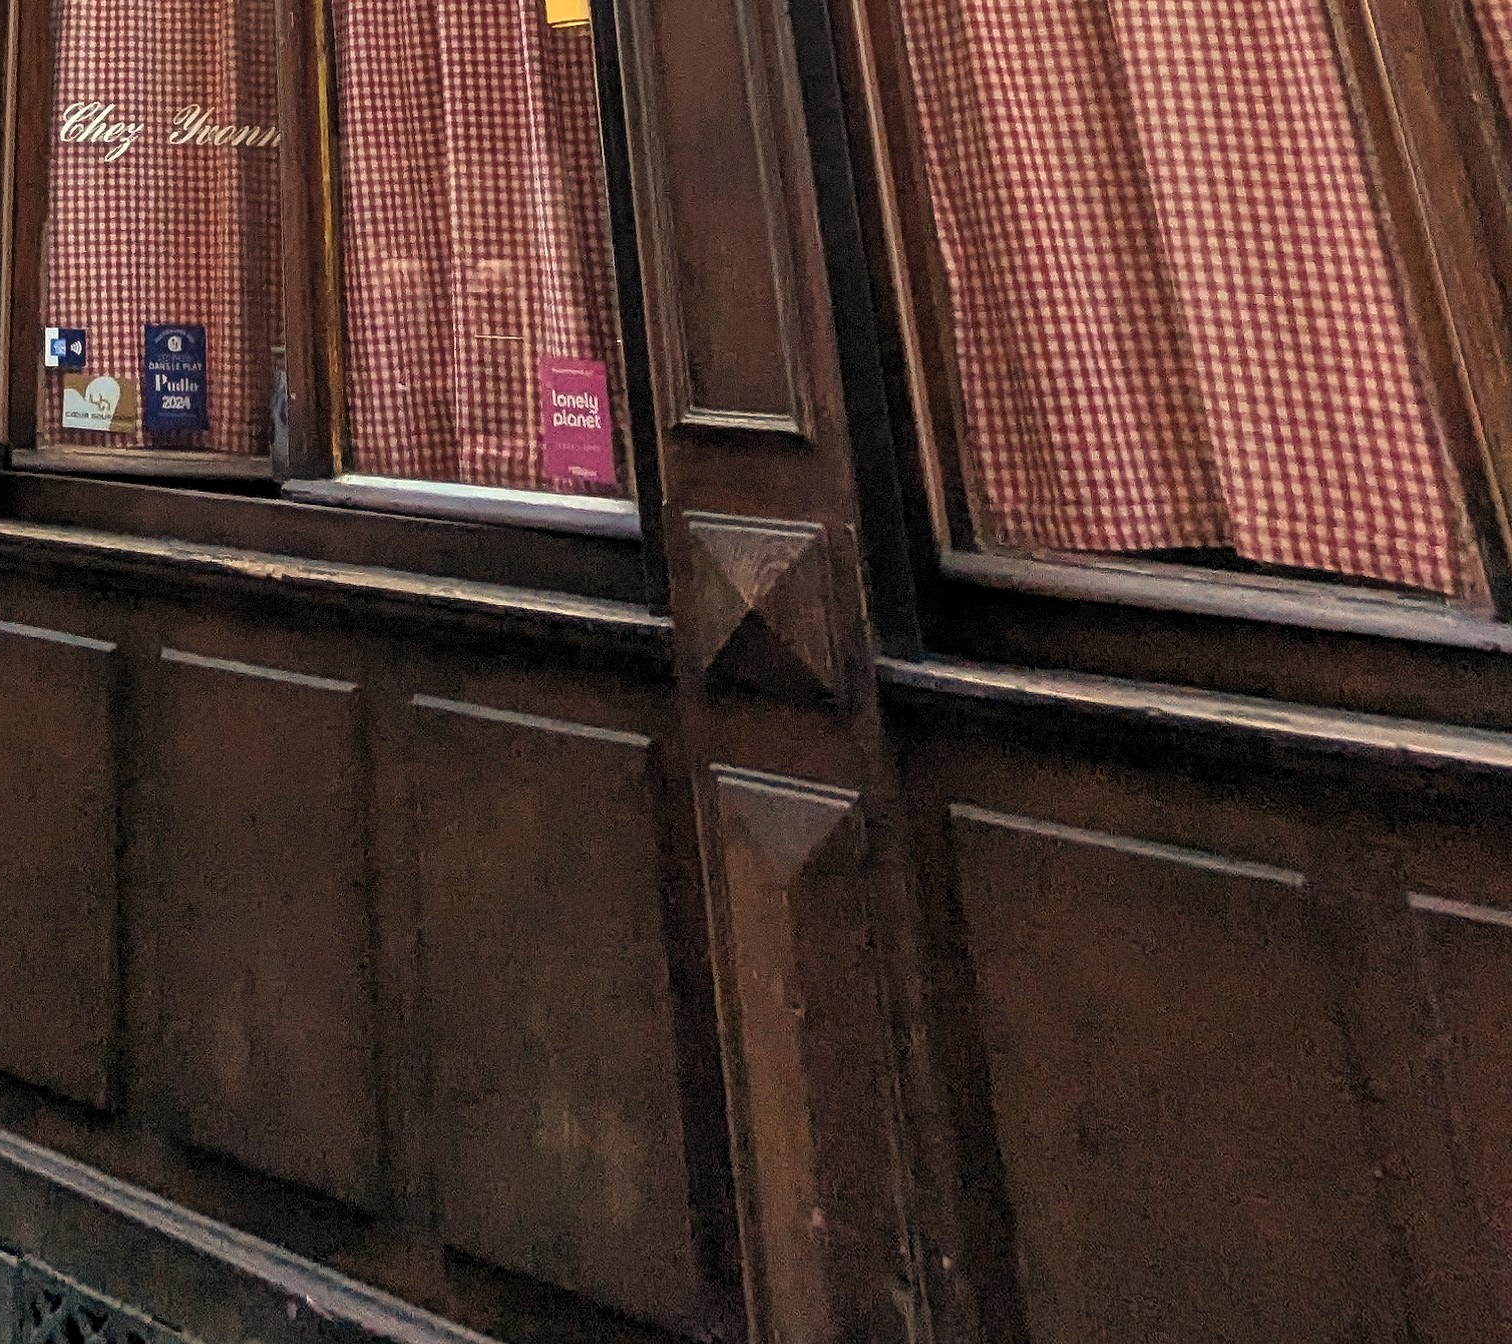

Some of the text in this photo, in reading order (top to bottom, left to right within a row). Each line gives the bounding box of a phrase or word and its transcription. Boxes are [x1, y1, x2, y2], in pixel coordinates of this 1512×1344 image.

[60, 101, 144, 162] Chez
[552, 389, 600, 414] lonely
[553, 409, 602, 429] planet
